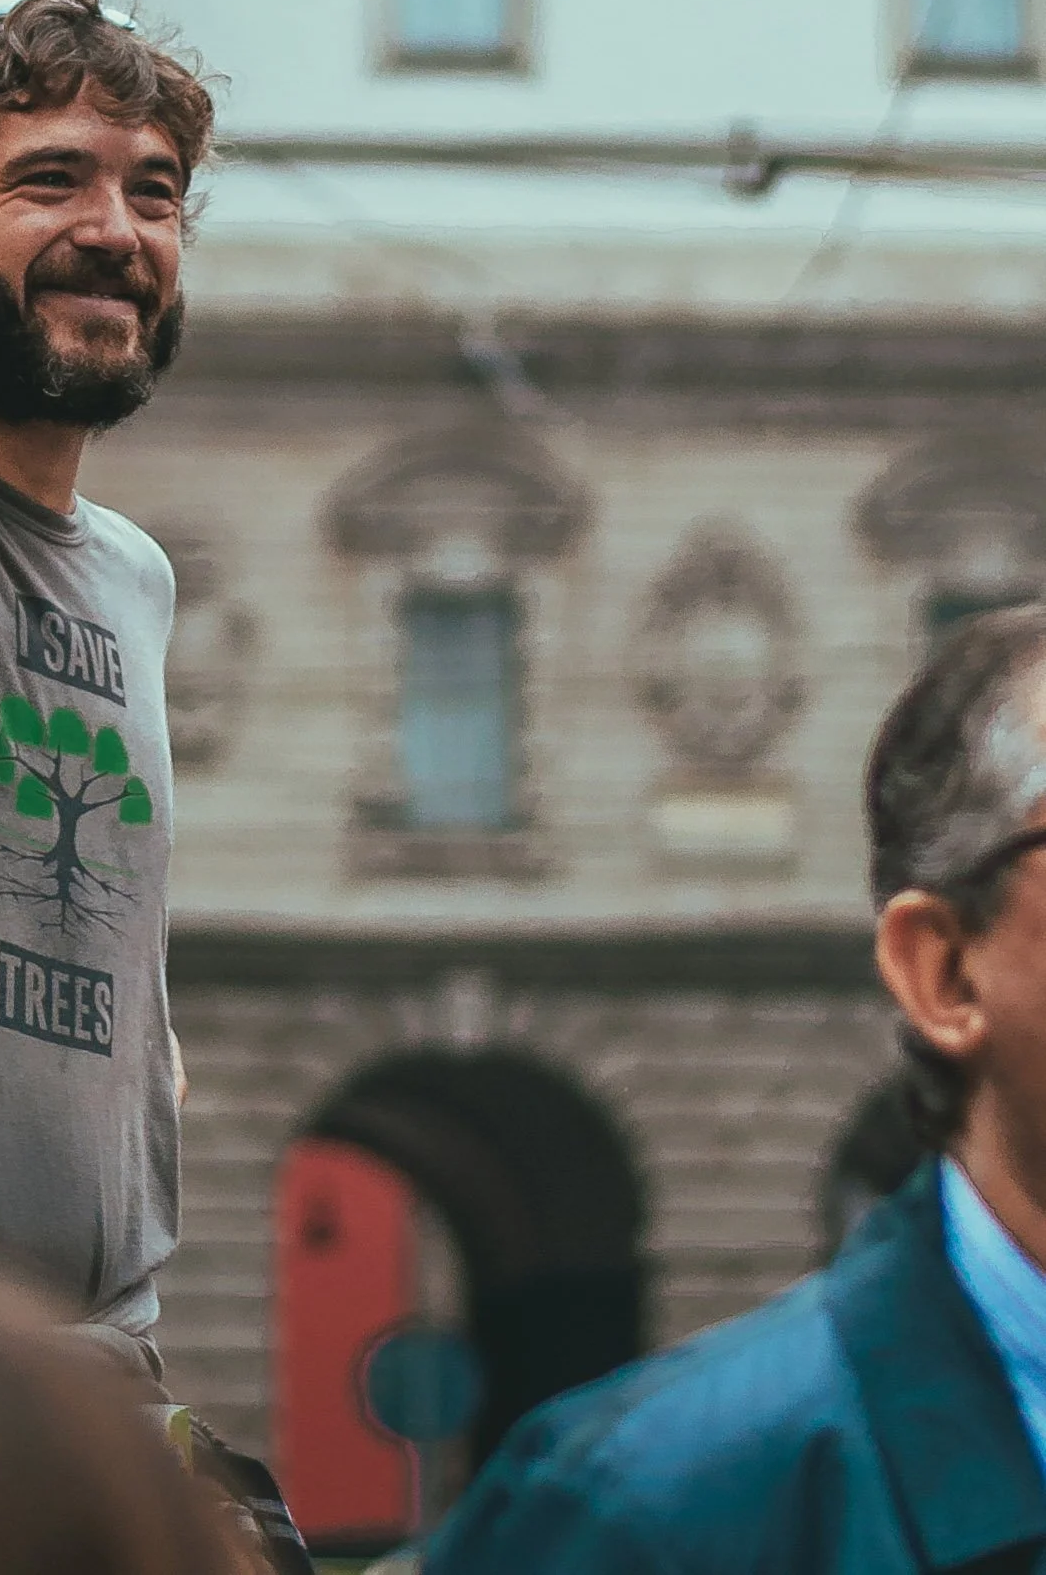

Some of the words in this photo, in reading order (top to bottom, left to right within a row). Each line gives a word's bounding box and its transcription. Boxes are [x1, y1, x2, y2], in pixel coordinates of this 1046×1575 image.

[17, 599, 29, 658] I
[40, 611, 125, 698] SAVE
[0, 951, 112, 1045] TREES
